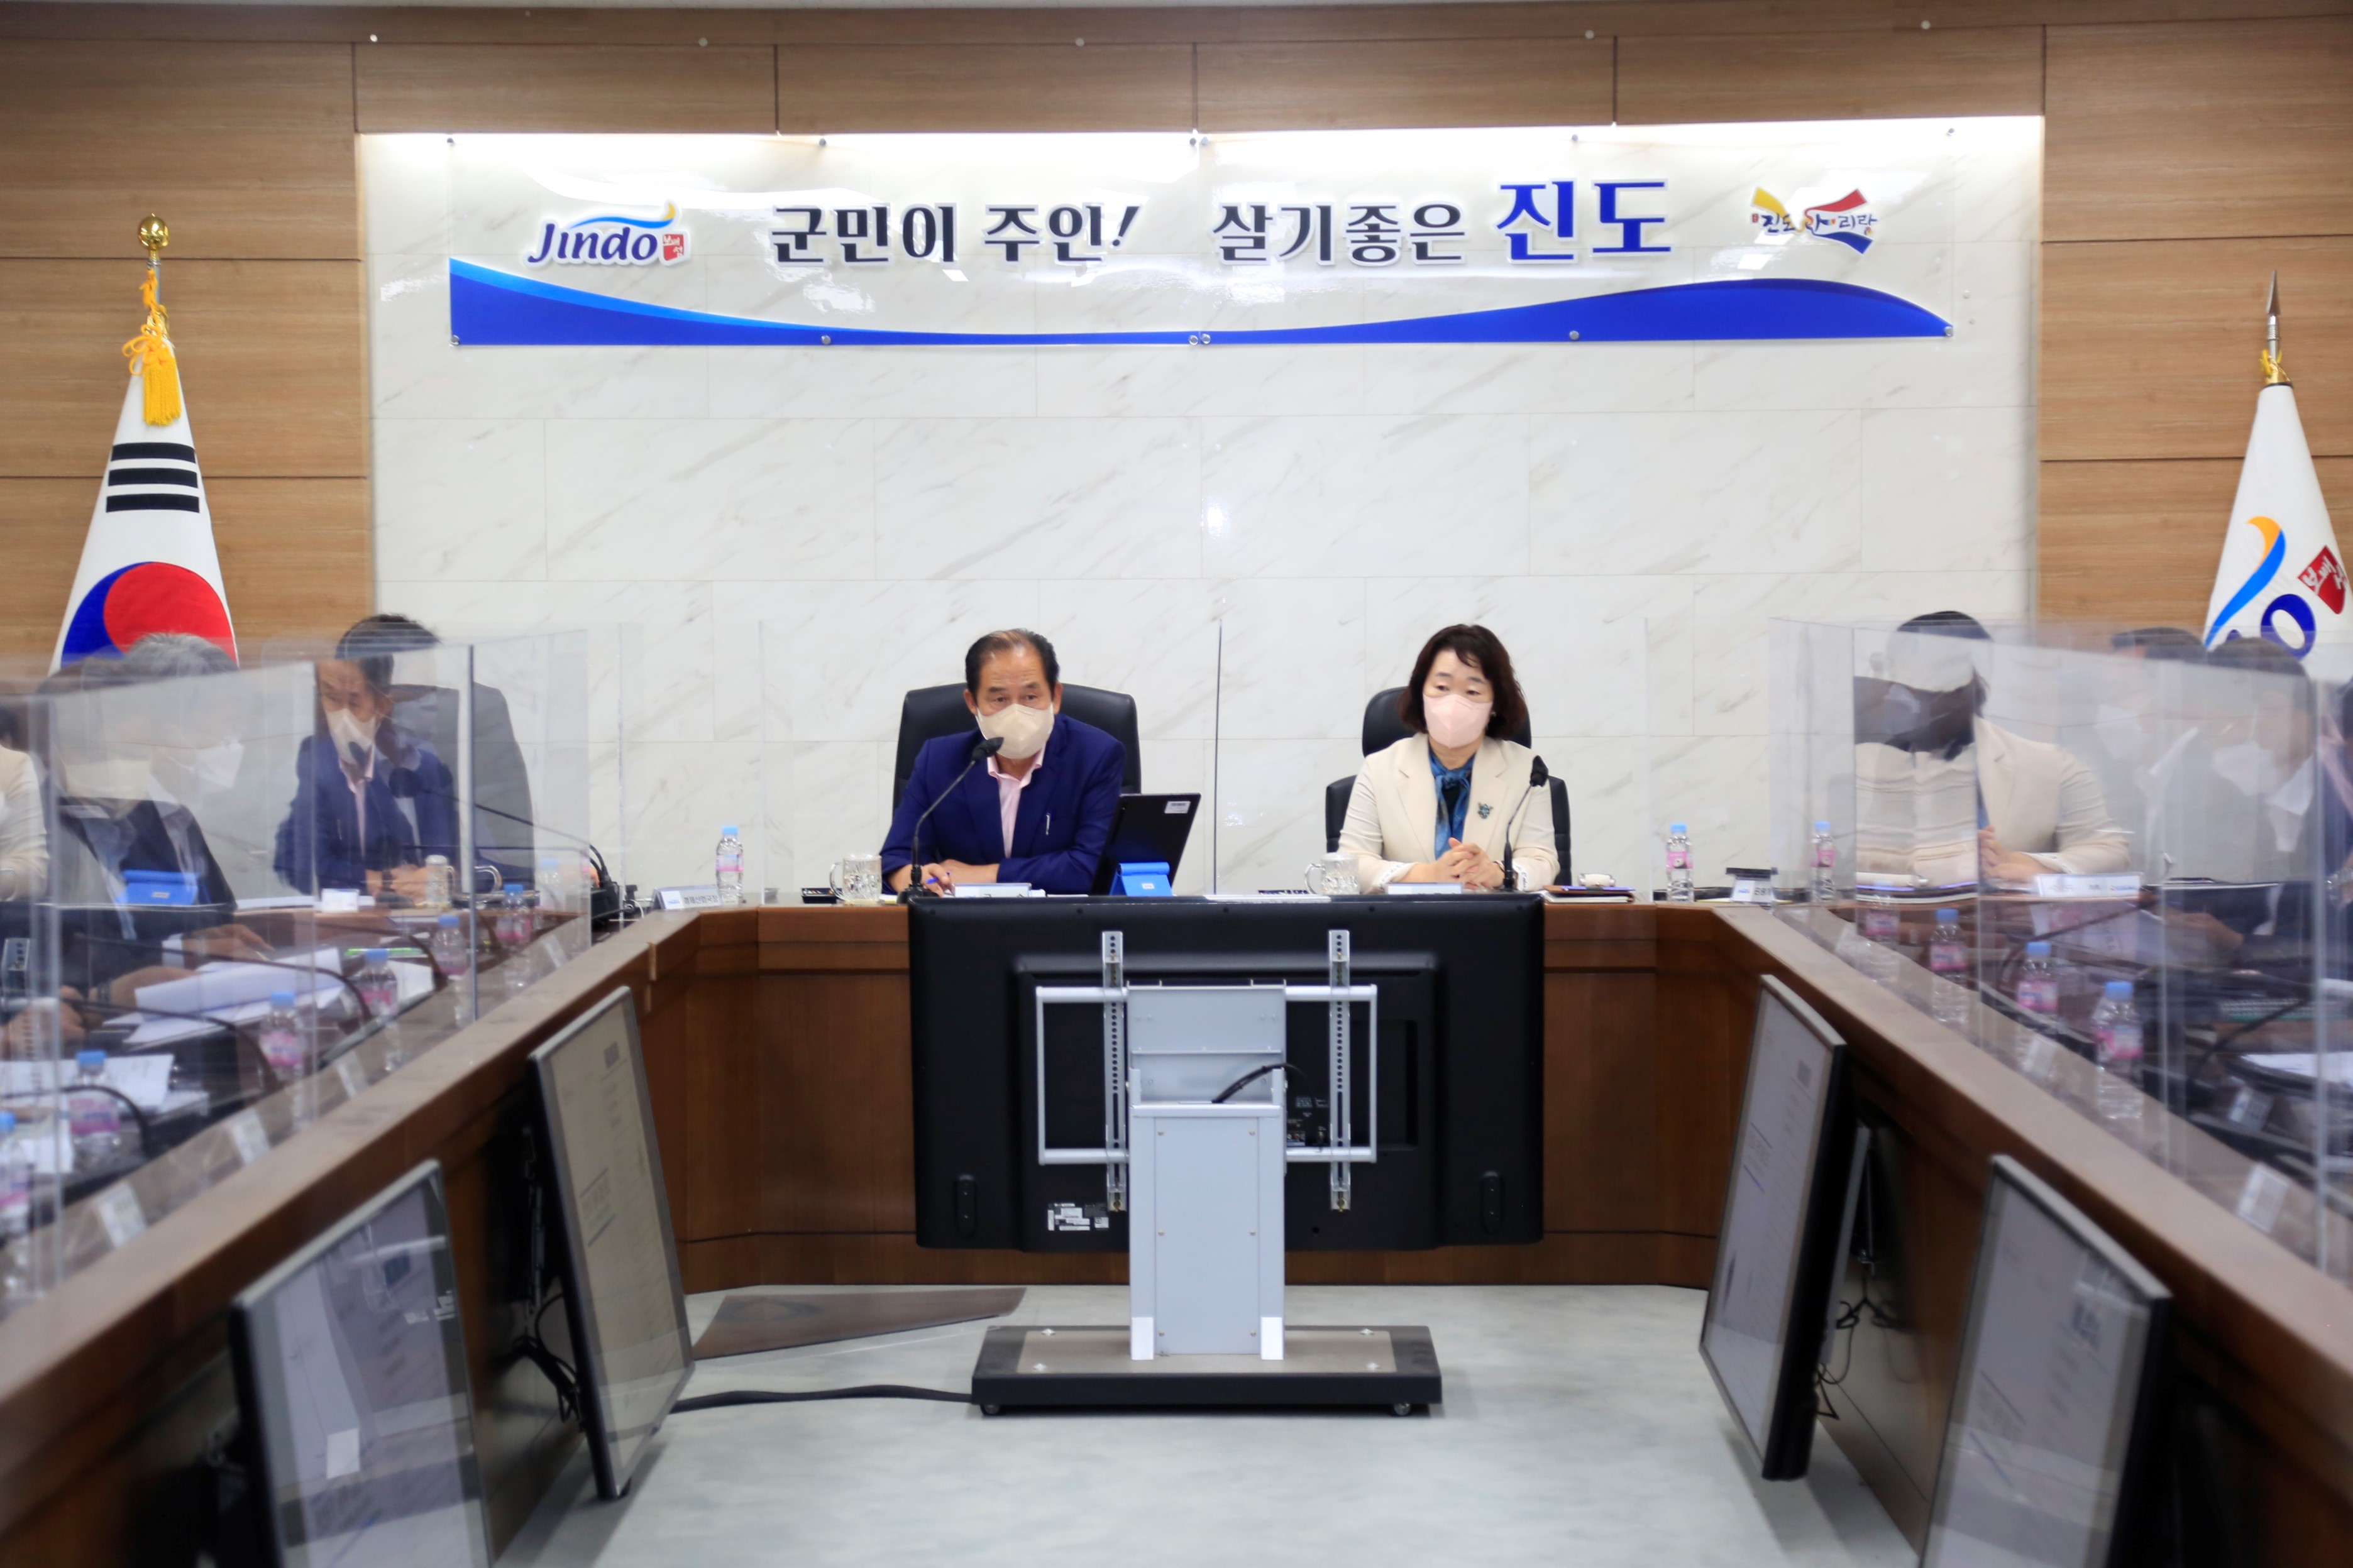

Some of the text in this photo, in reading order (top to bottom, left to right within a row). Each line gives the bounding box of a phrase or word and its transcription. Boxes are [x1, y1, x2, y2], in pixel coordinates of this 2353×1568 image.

[527, 223, 658, 263] Jindo
[771, 181, 1672, 263] 군민이 주인! 살기좋은 진도
